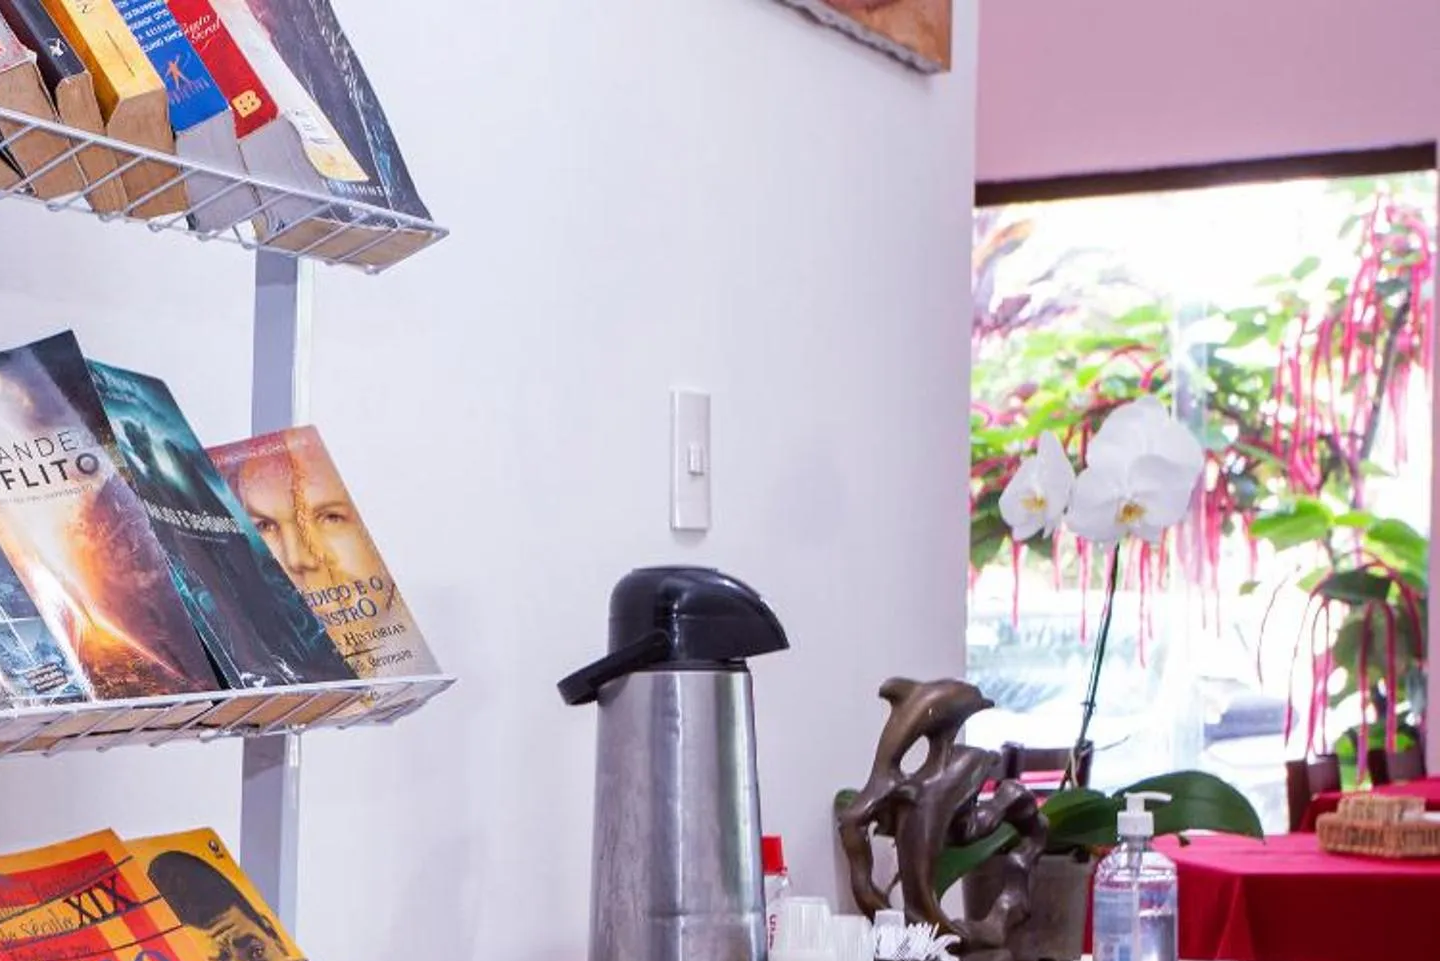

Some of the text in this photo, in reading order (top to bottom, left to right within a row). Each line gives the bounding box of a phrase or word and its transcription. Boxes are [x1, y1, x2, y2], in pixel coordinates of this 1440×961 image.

[356, 575, 384, 595] E O
[323, 596, 378, 626] NSTRO
[62, 870, 143, 929] XIX
